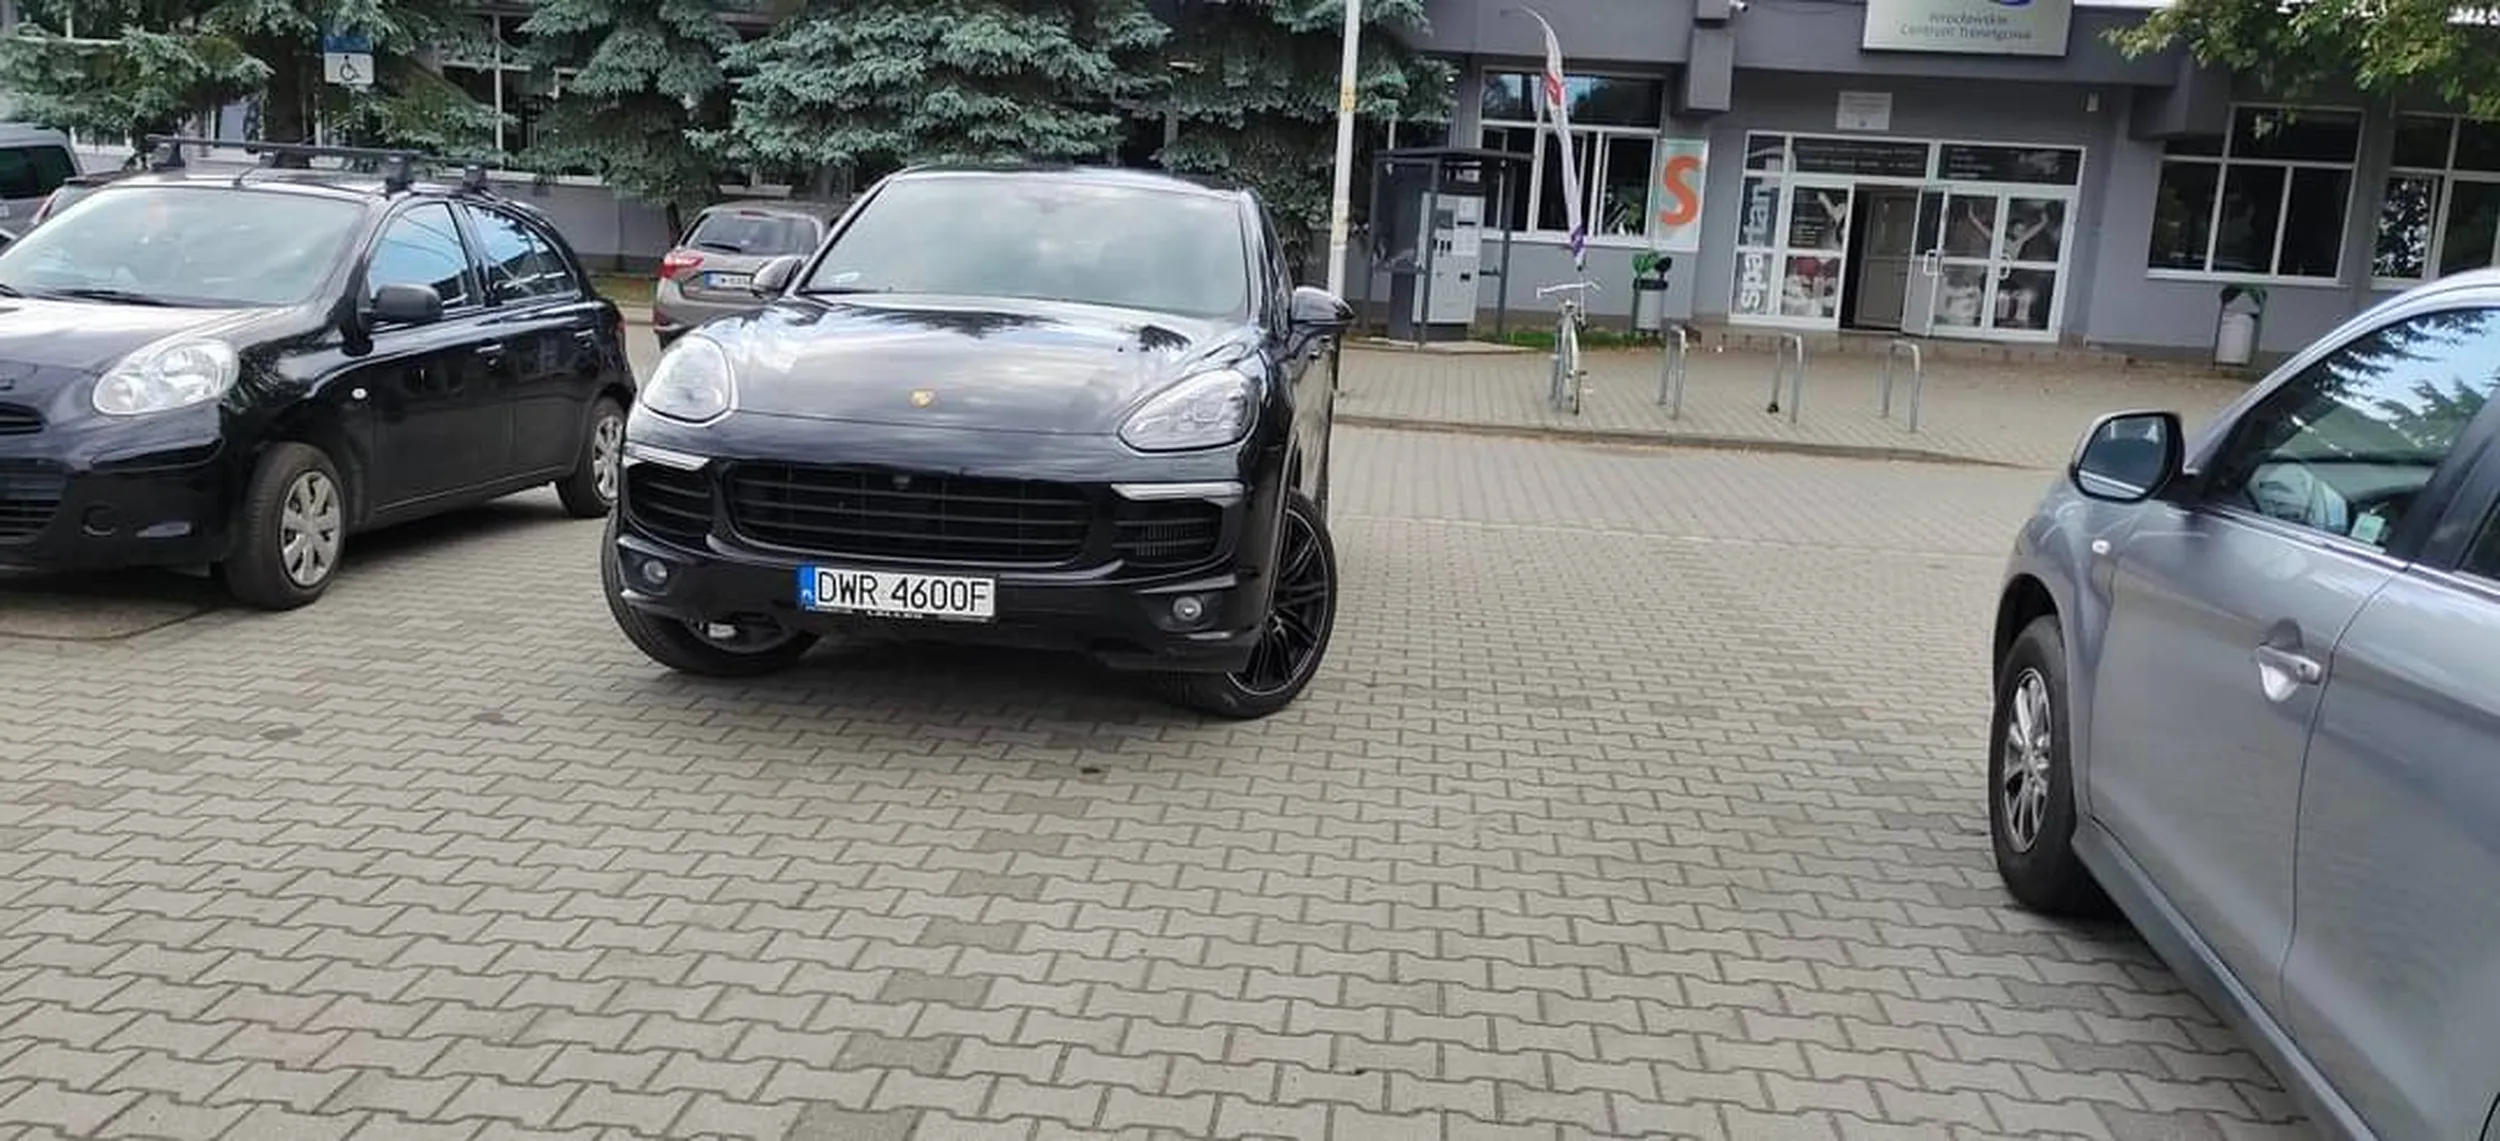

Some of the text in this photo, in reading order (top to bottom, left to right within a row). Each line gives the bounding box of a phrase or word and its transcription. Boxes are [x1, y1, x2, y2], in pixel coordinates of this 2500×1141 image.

[1660, 155, 1703, 225] S
[818, 571, 878, 605] DWR
[890, 577, 990, 612] 4600F
